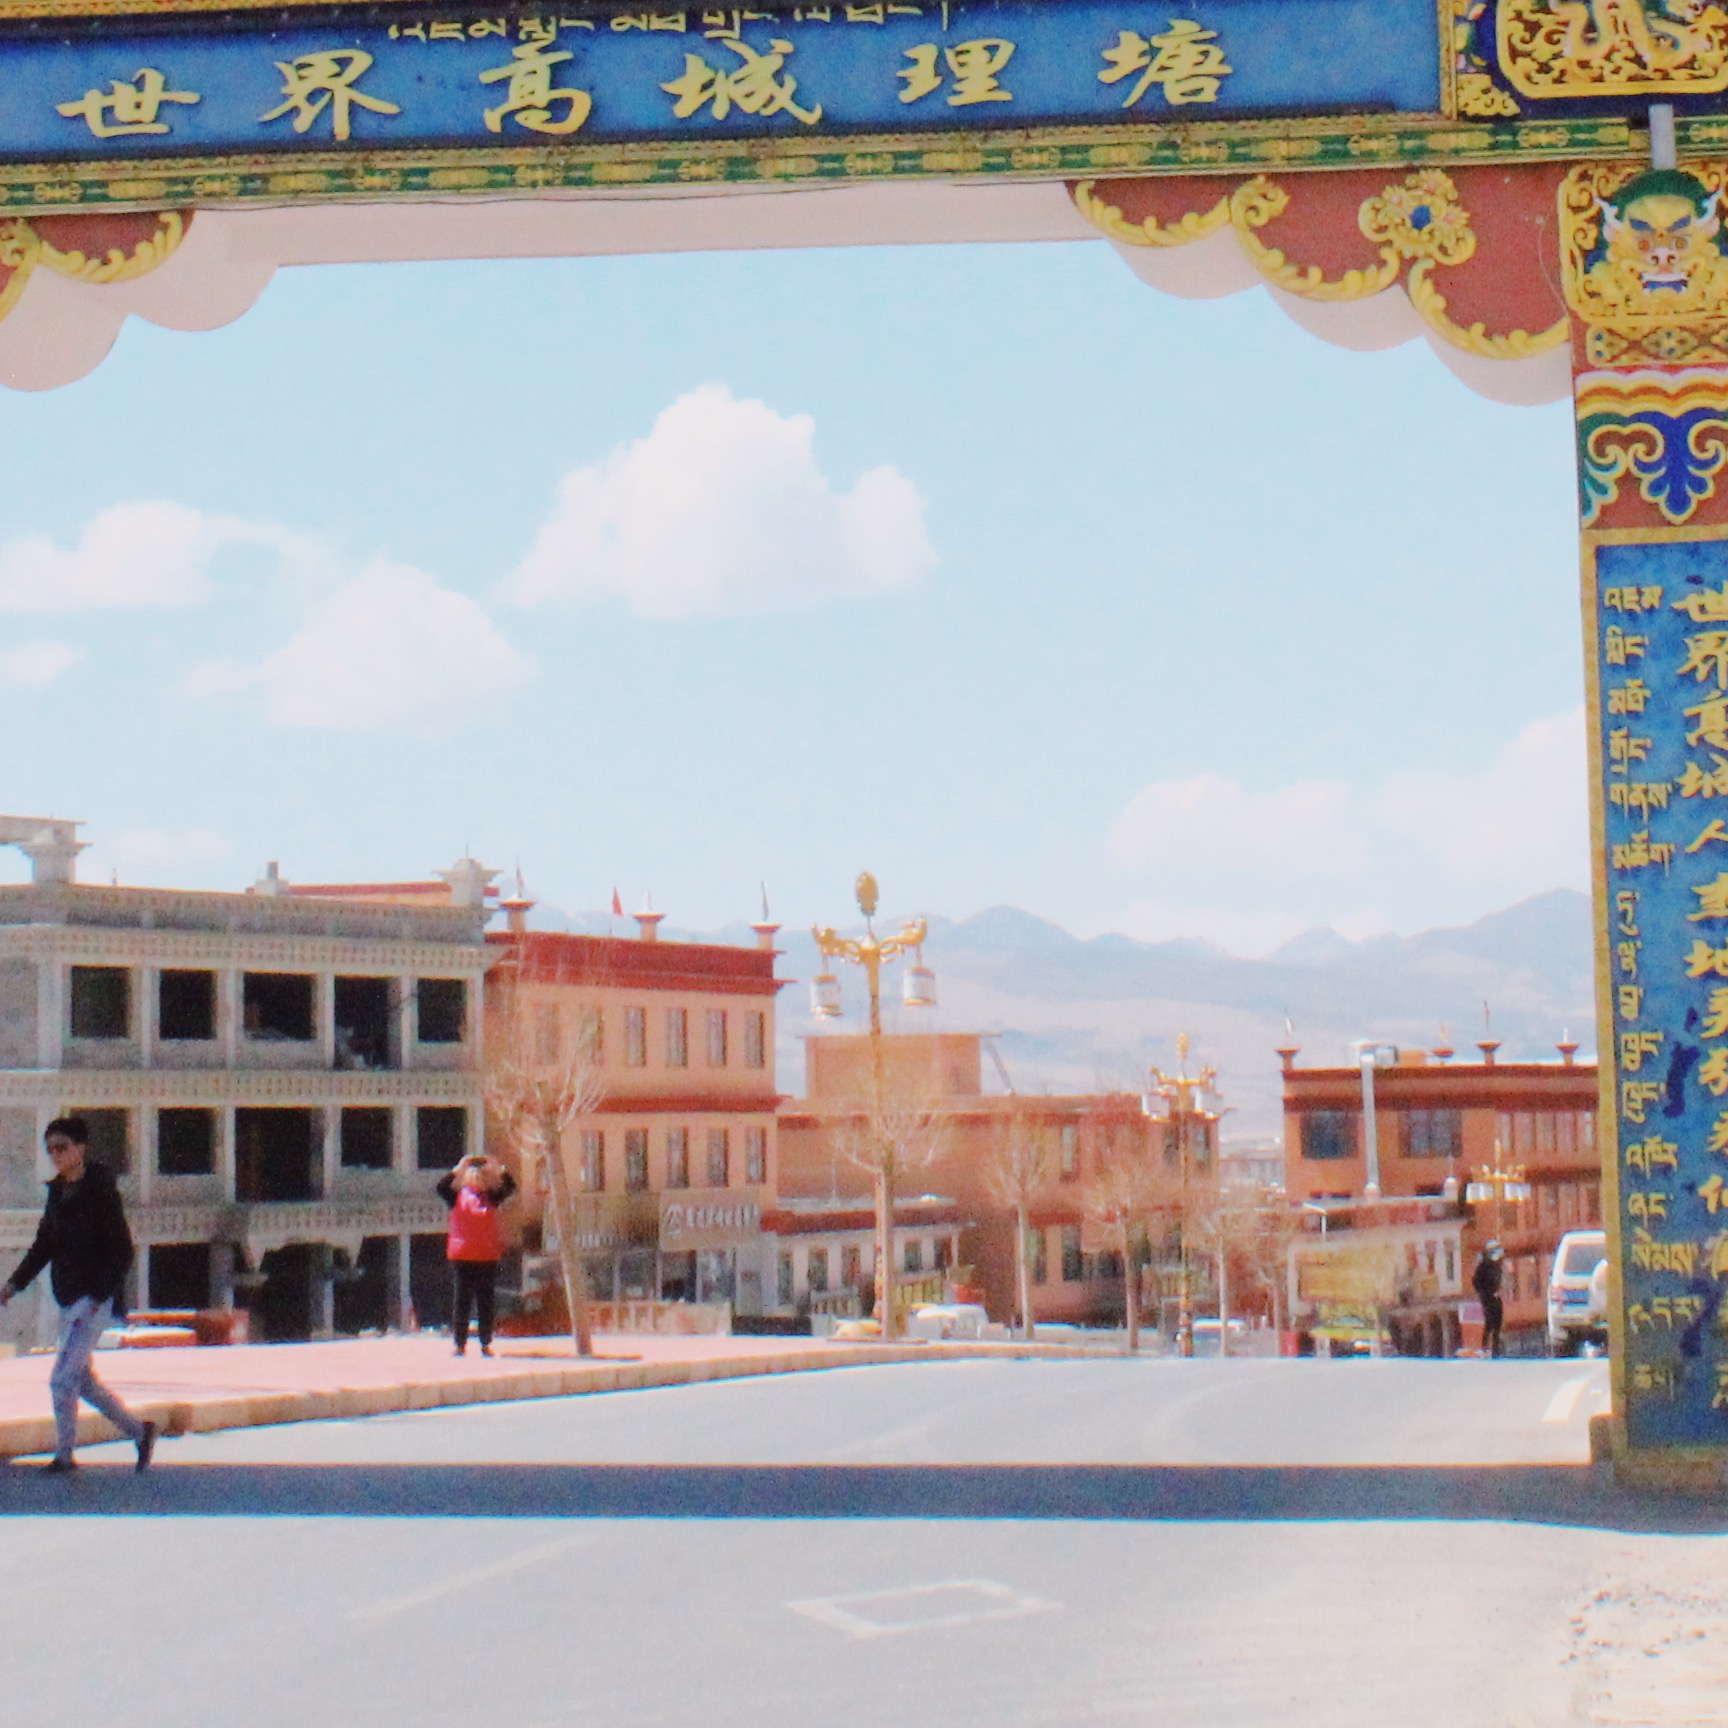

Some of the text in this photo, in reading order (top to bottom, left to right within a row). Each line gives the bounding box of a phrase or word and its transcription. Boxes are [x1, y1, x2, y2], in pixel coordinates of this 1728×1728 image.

[56, 19, 1233, 140] 世界高城理塘
